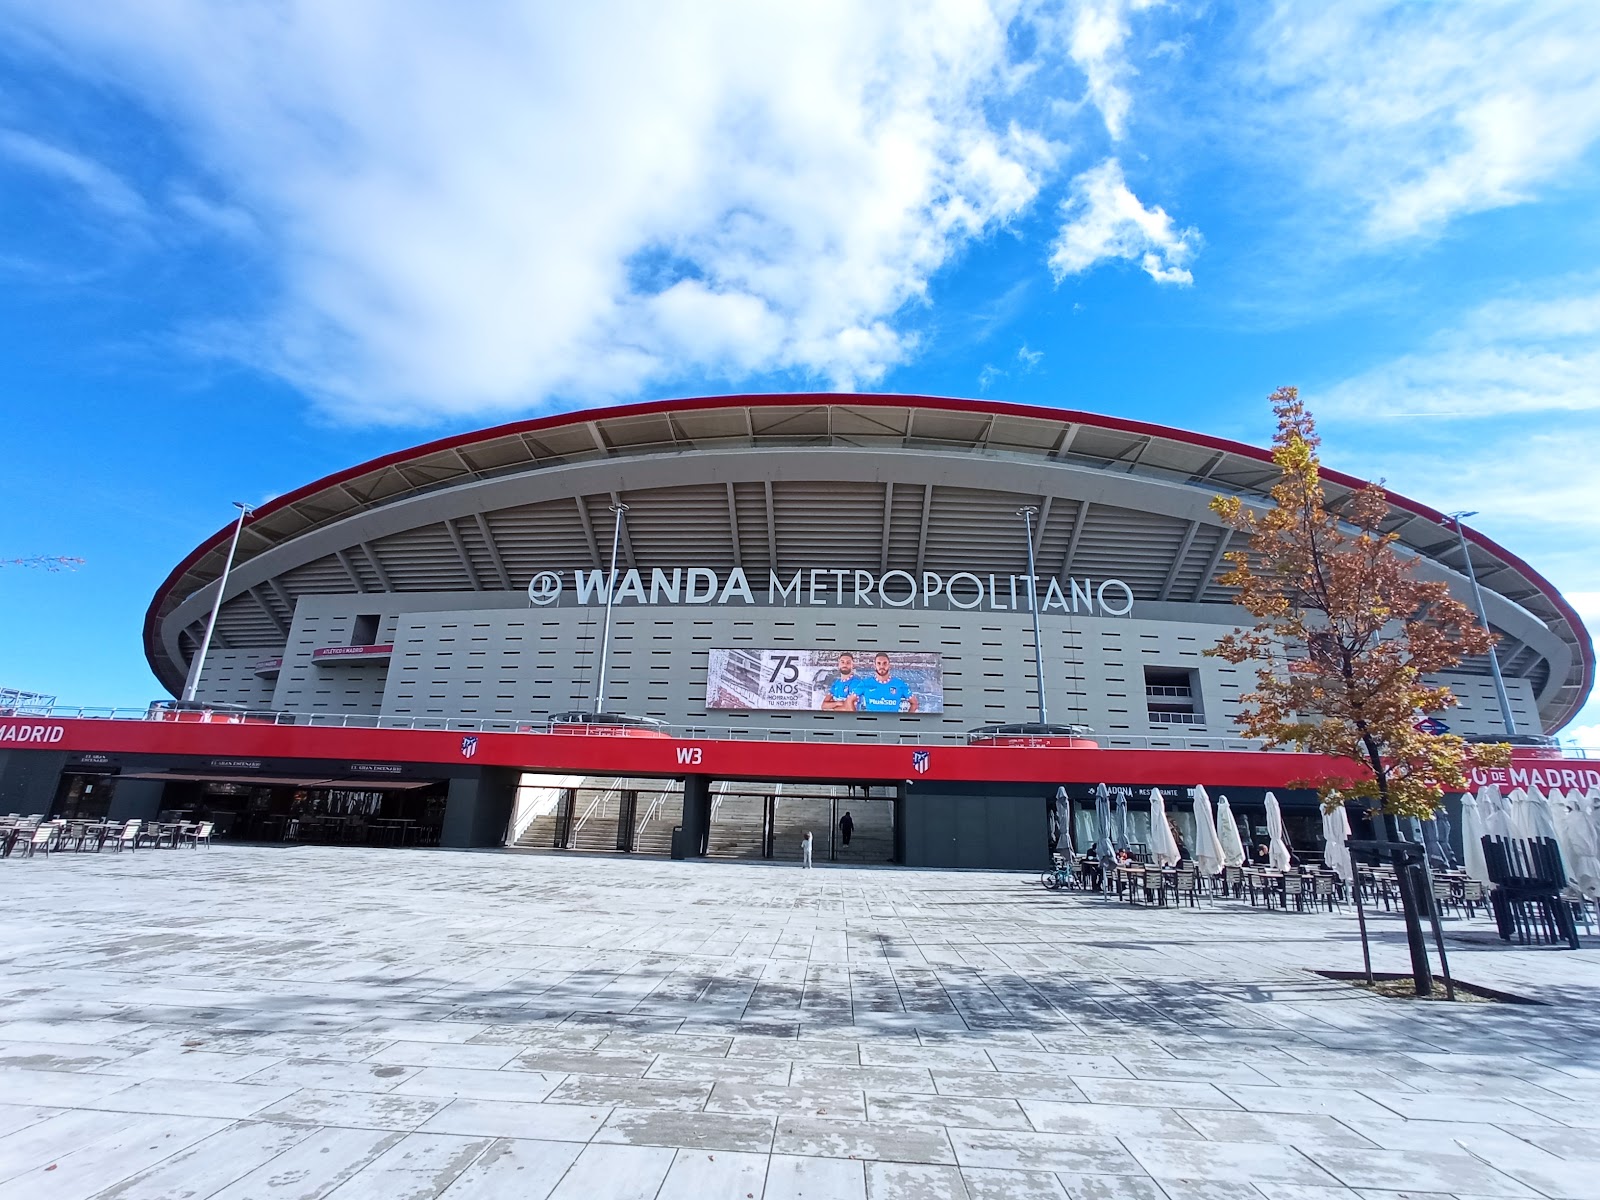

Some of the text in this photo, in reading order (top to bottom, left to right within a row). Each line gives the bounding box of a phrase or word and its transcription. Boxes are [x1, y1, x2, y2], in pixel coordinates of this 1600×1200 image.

[574, 568, 1134, 616] WANDA METROPOLITANO
[769, 656, 799, 683] 75
[768, 683, 799, 694] AÑOS
[676, 747, 703, 765] W3
[1491, 771, 1506, 782] DE
[1508, 768, 1600, 789] MADRID
[1139, 789, 1178, 797] RESTRANTE
